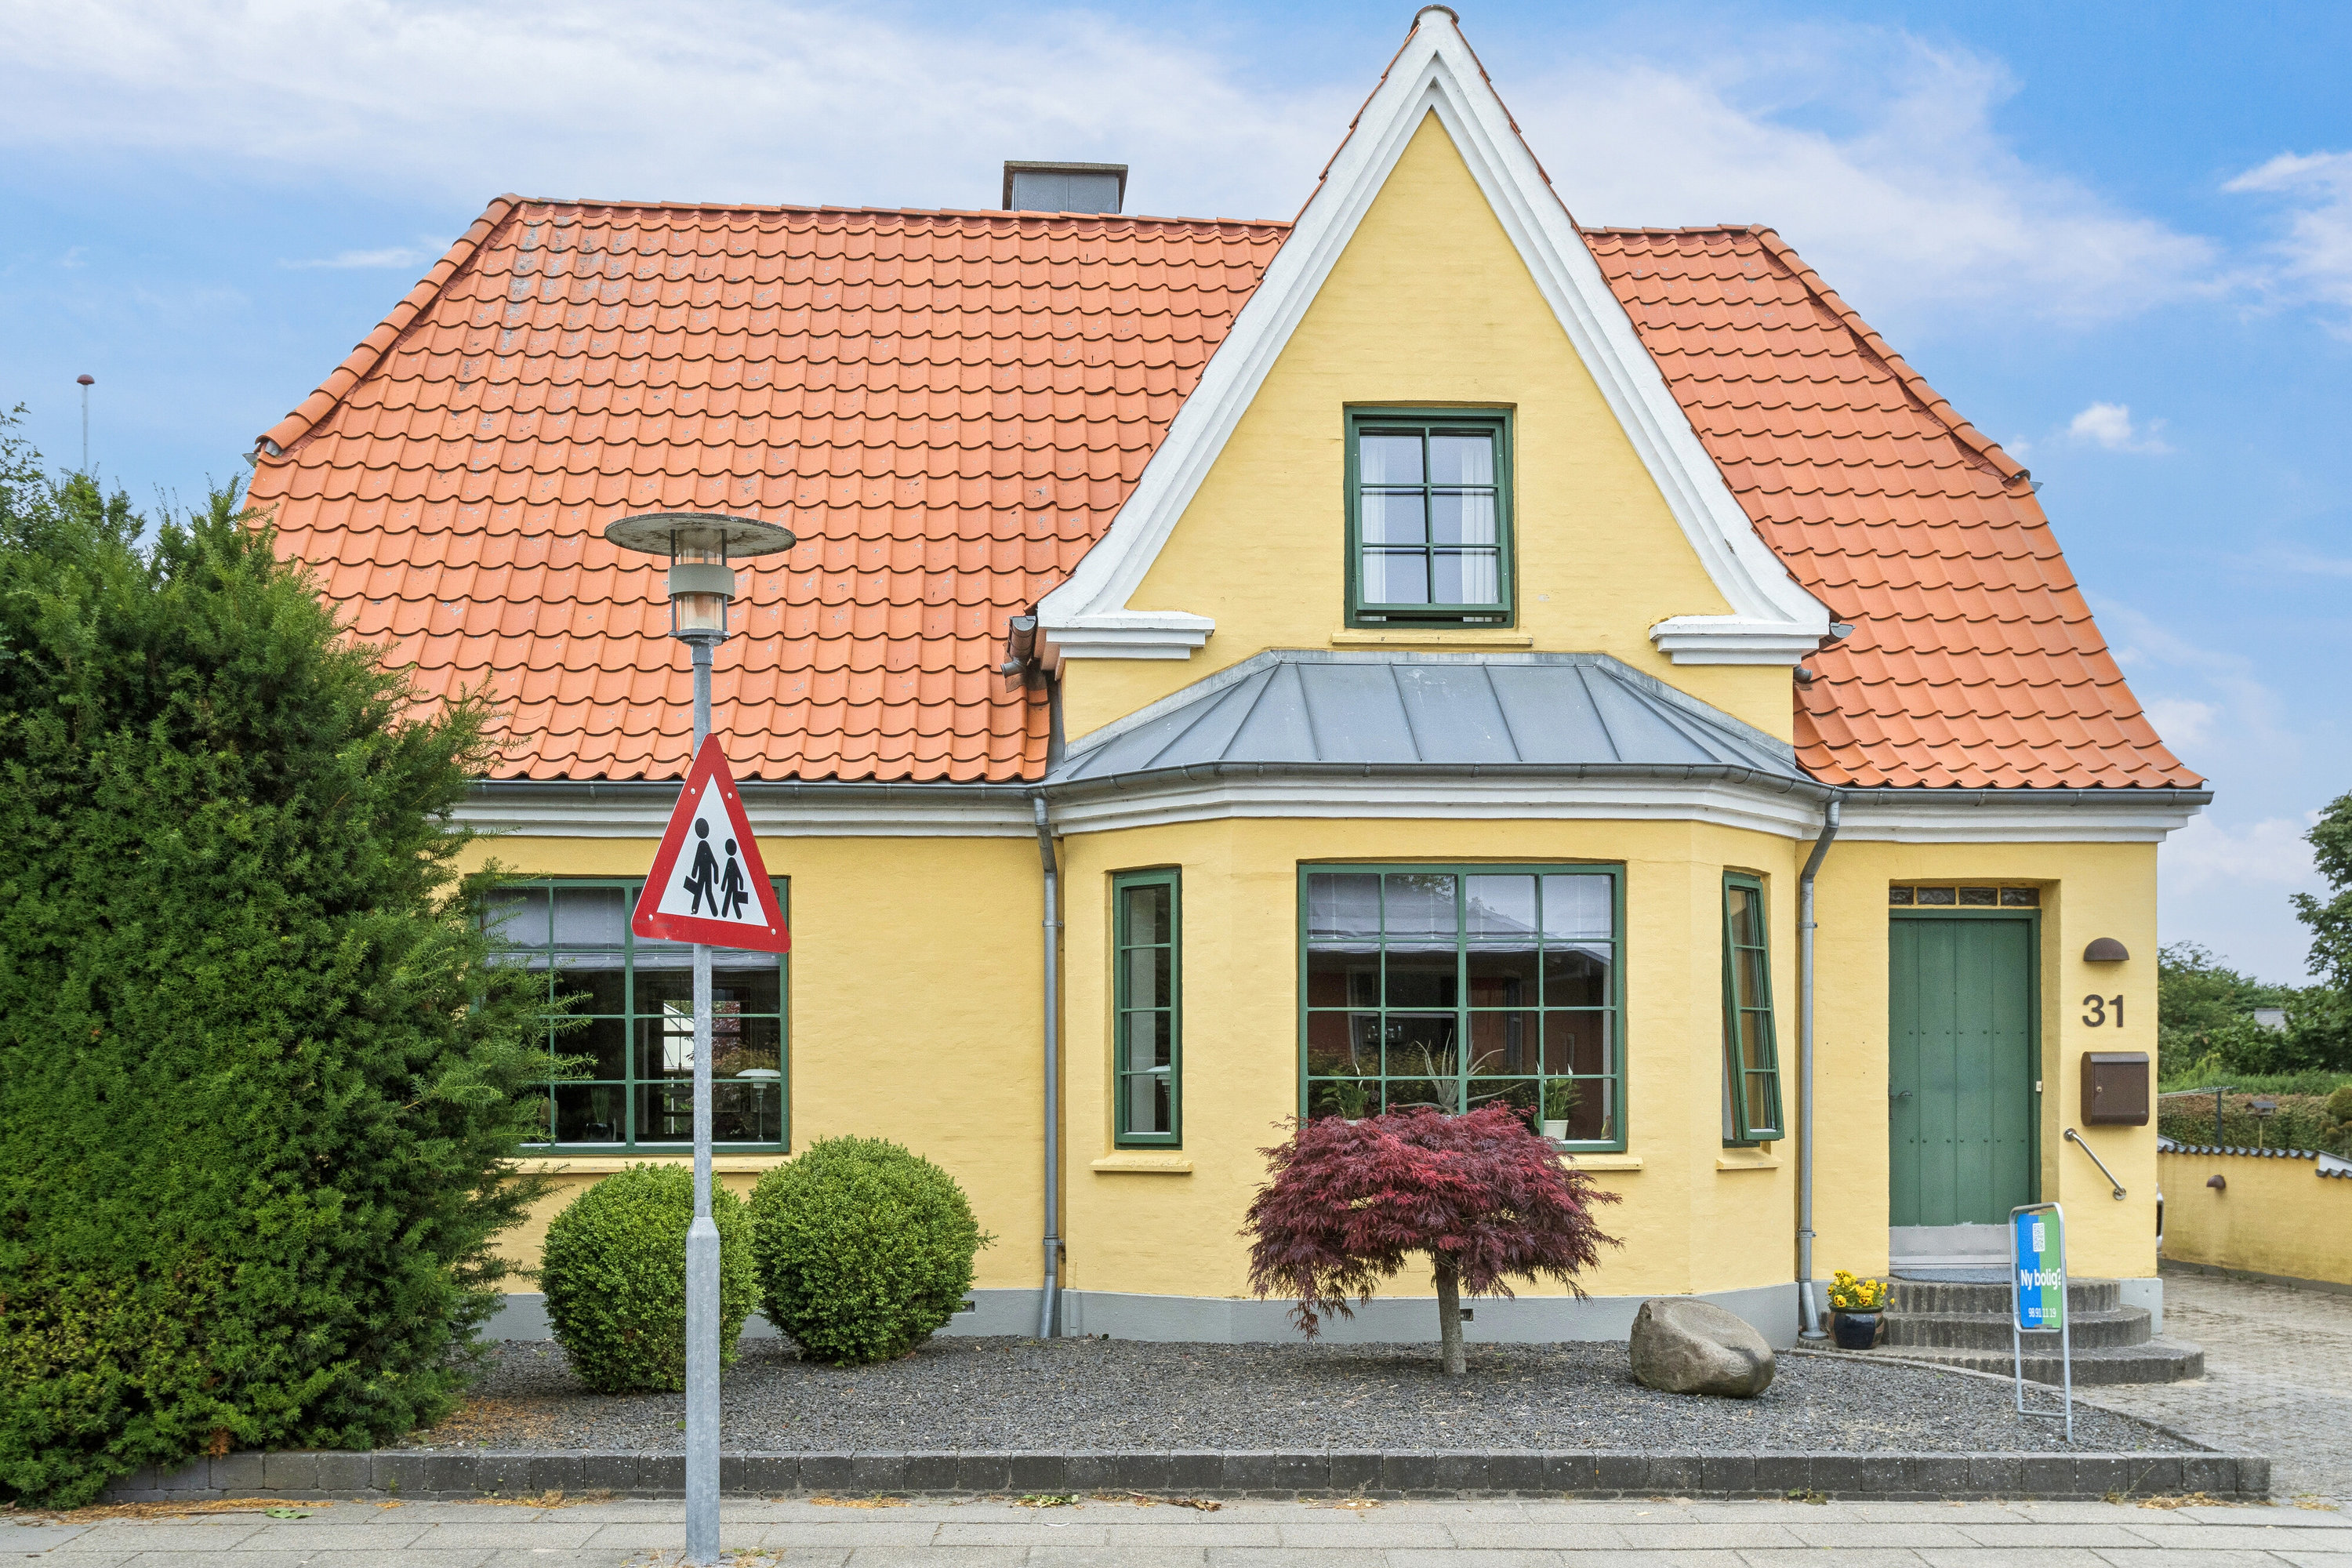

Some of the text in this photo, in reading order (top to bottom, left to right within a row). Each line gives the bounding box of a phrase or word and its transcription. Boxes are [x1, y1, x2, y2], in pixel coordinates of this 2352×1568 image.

[2082, 994, 2123, 1028] 31
[2020, 1268, 2061, 1290] Ny bolig?
[2028, 1307, 2056, 1318] 98 91 11 19
